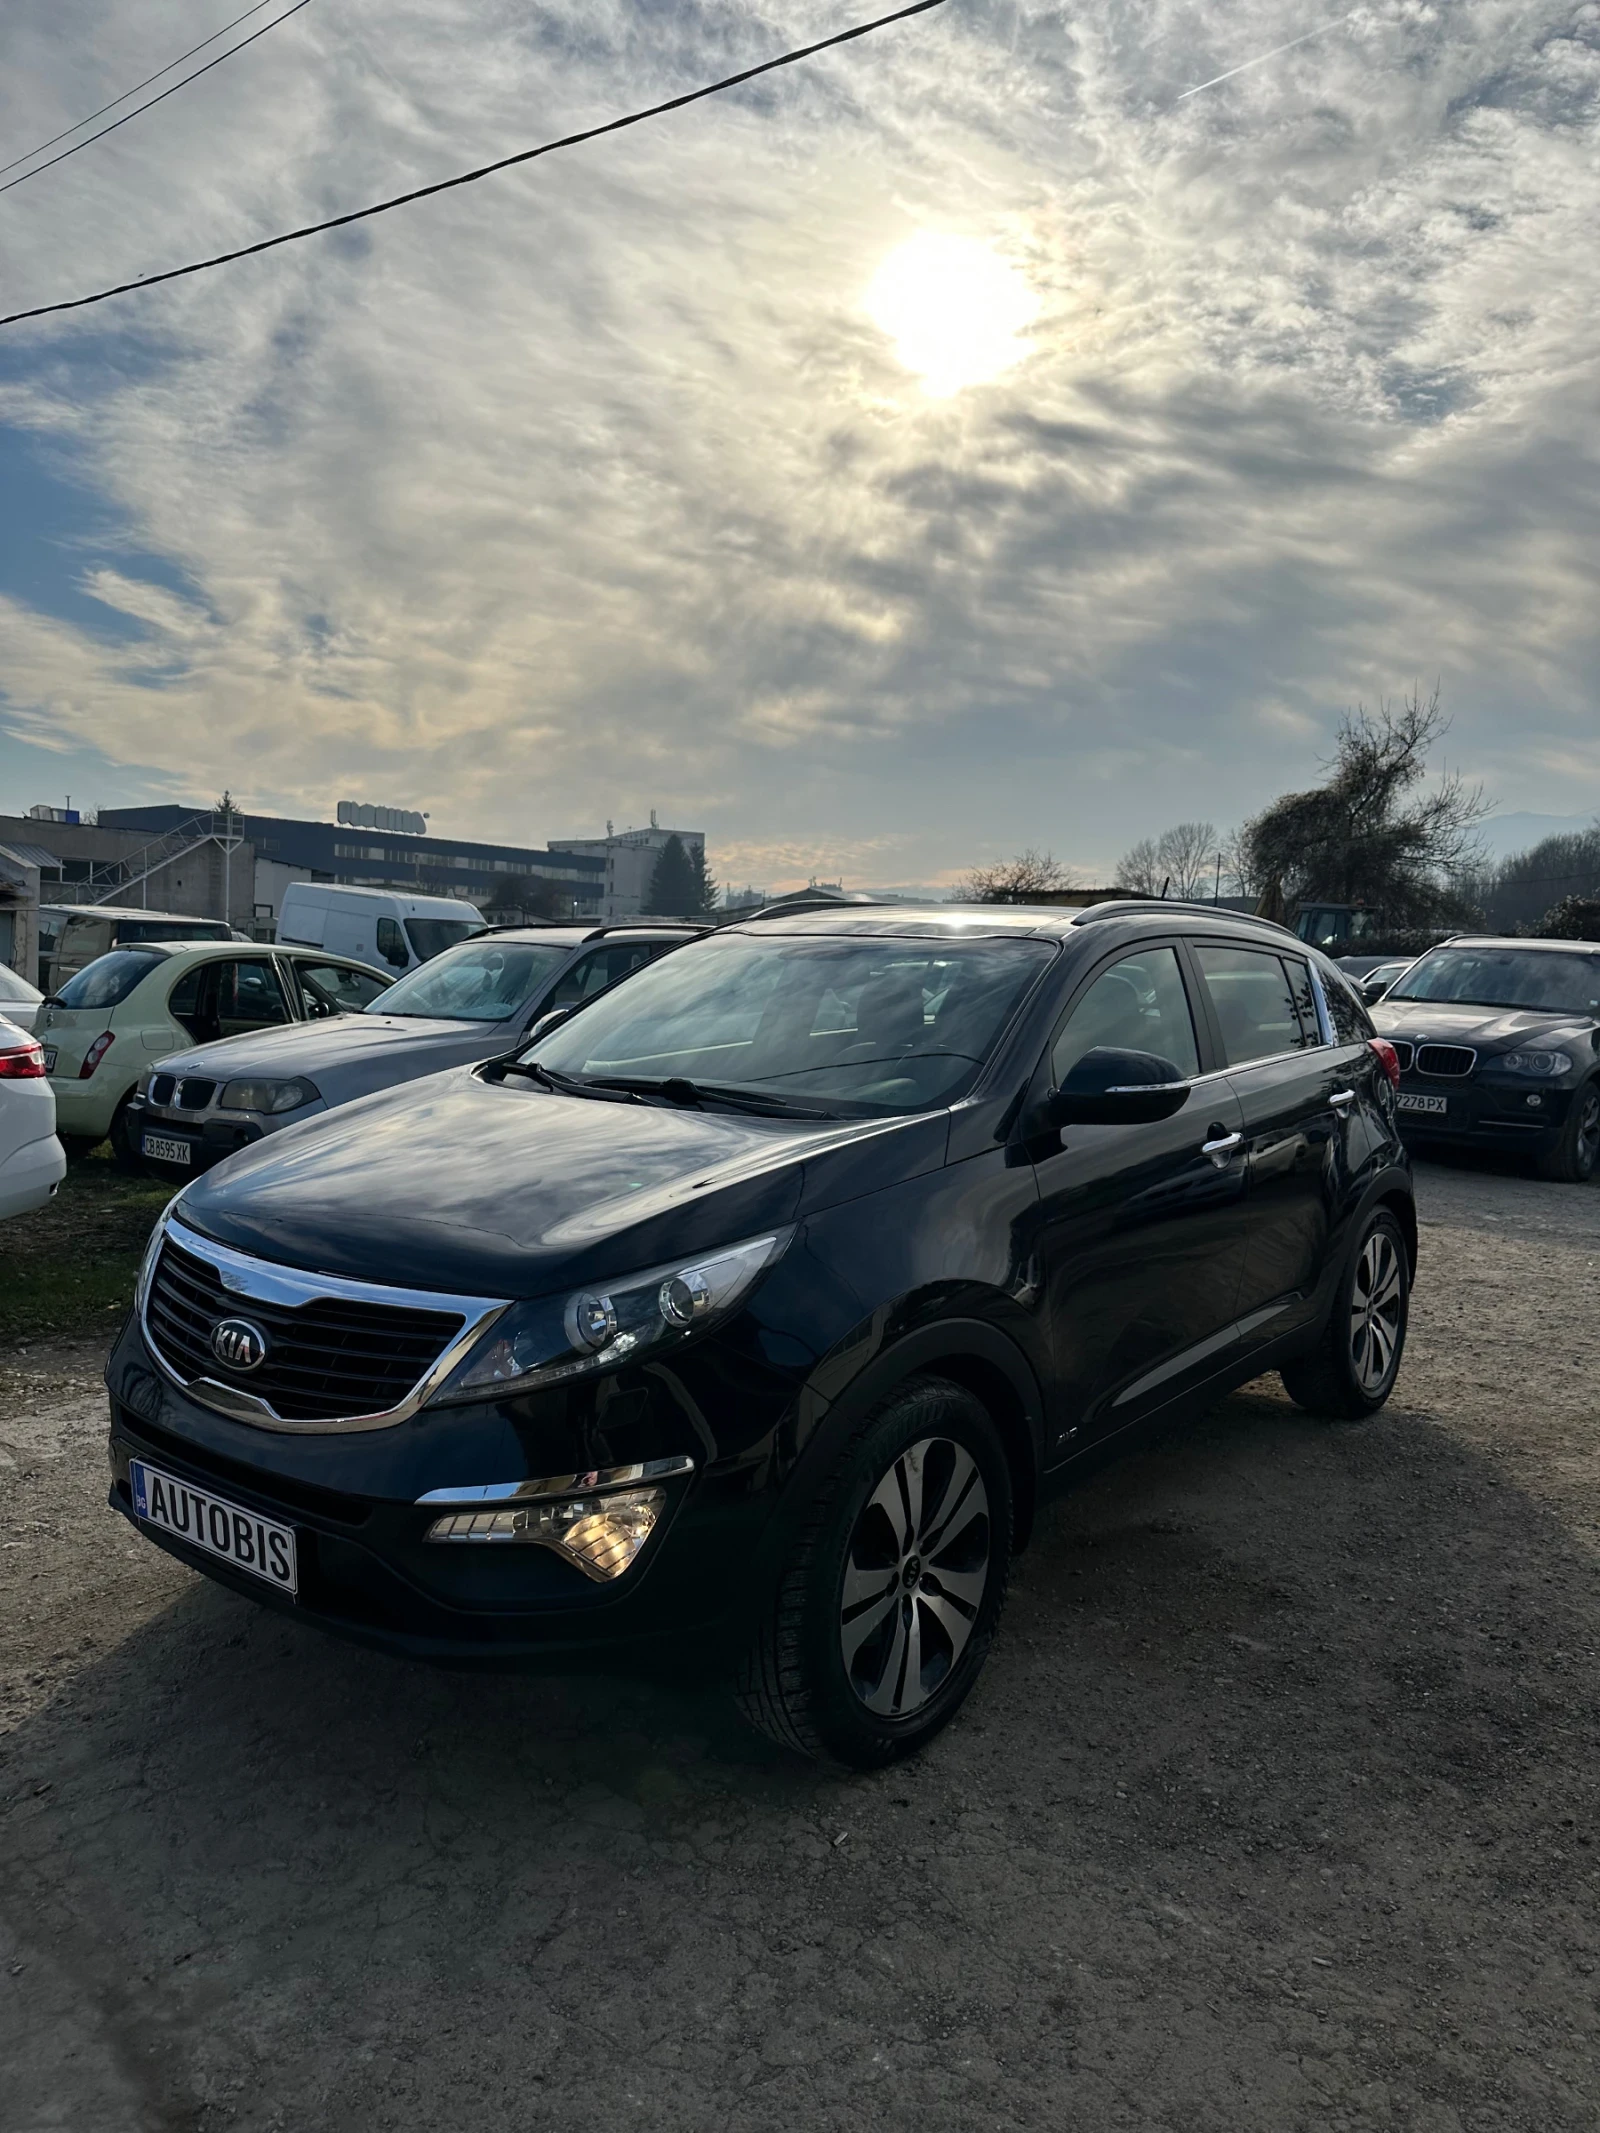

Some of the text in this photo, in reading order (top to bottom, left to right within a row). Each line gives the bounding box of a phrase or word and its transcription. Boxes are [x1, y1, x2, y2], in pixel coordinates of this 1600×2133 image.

[1427, 1098, 1444, 1111] PX
[176, 1143, 188, 1162] XK
[215, 1327, 252, 1363] KIA
[136, 1476, 291, 1581] BG AUTOBIS
